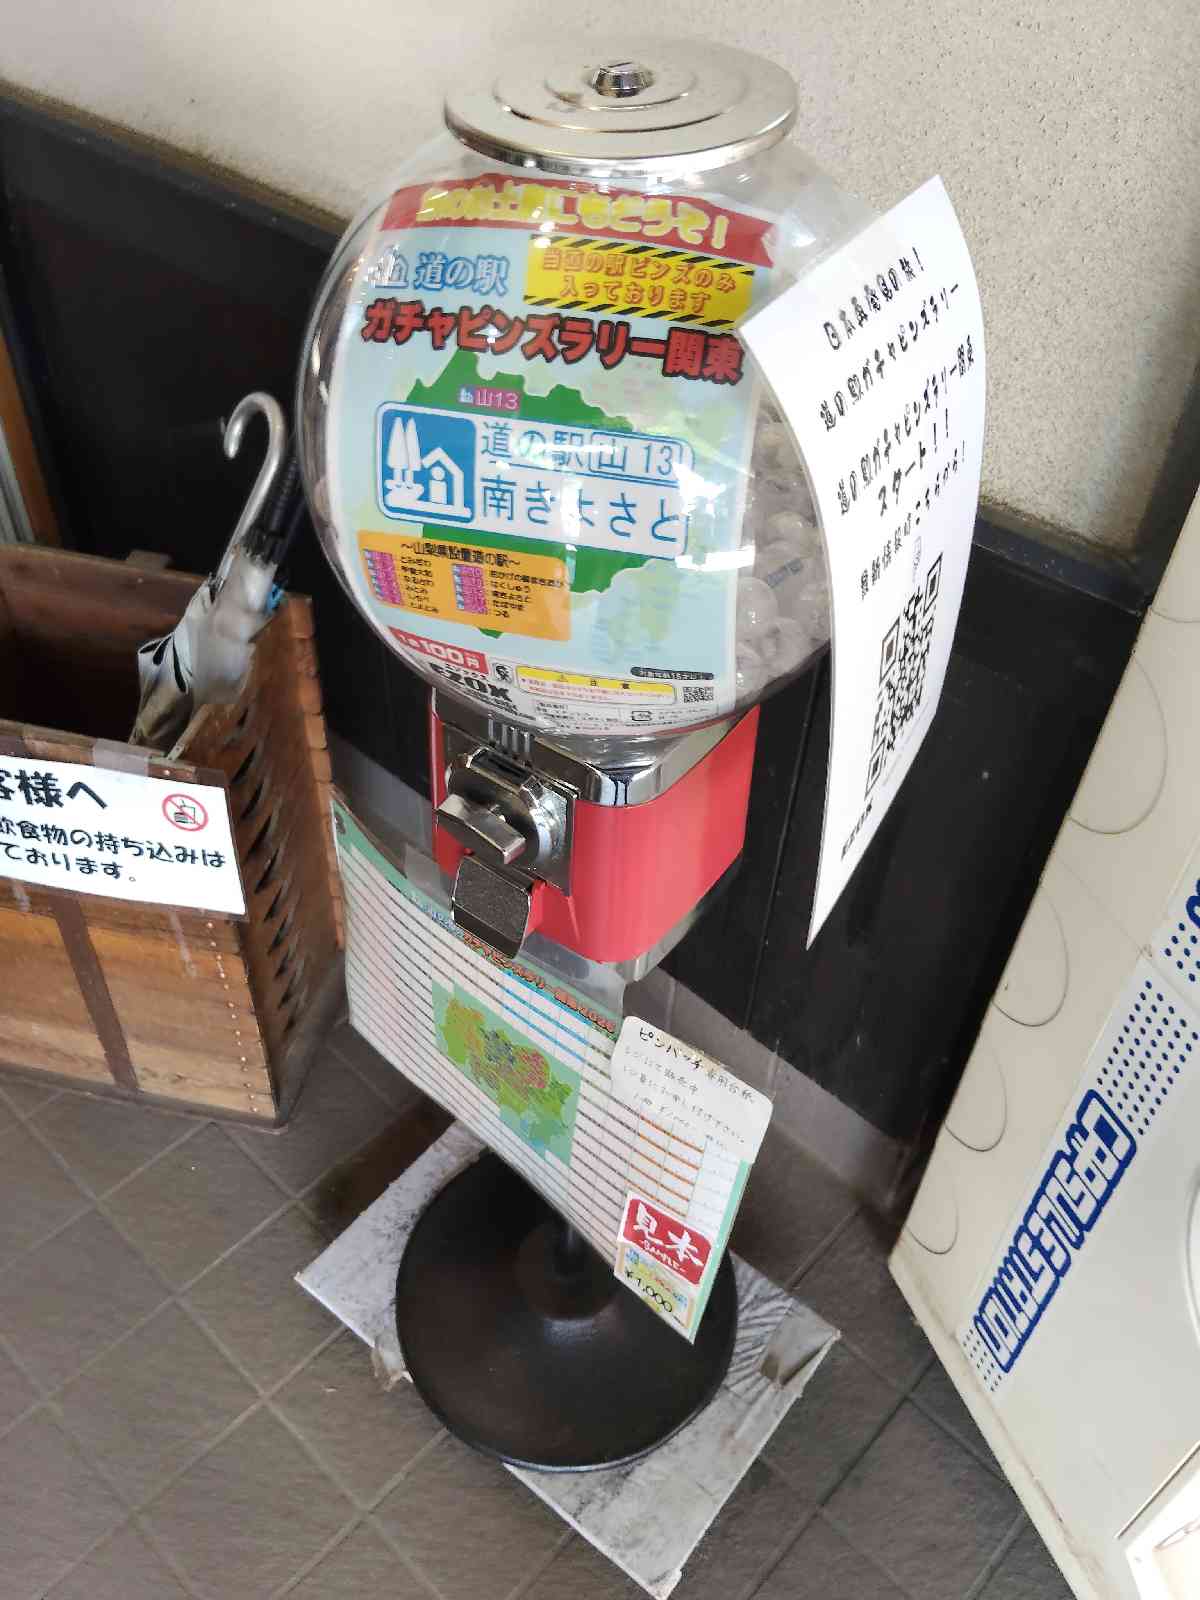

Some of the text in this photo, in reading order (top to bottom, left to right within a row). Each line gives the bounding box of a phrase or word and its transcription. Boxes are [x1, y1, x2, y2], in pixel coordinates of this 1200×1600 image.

[413, 252, 510, 296] 道の駅
[561, 274, 711, 315] 入っております
[361, 298, 745, 385] ガチャピンズラリー関東
[480, 421, 584, 466] 道の駅
[480, 474, 679, 543] 南きよさと
